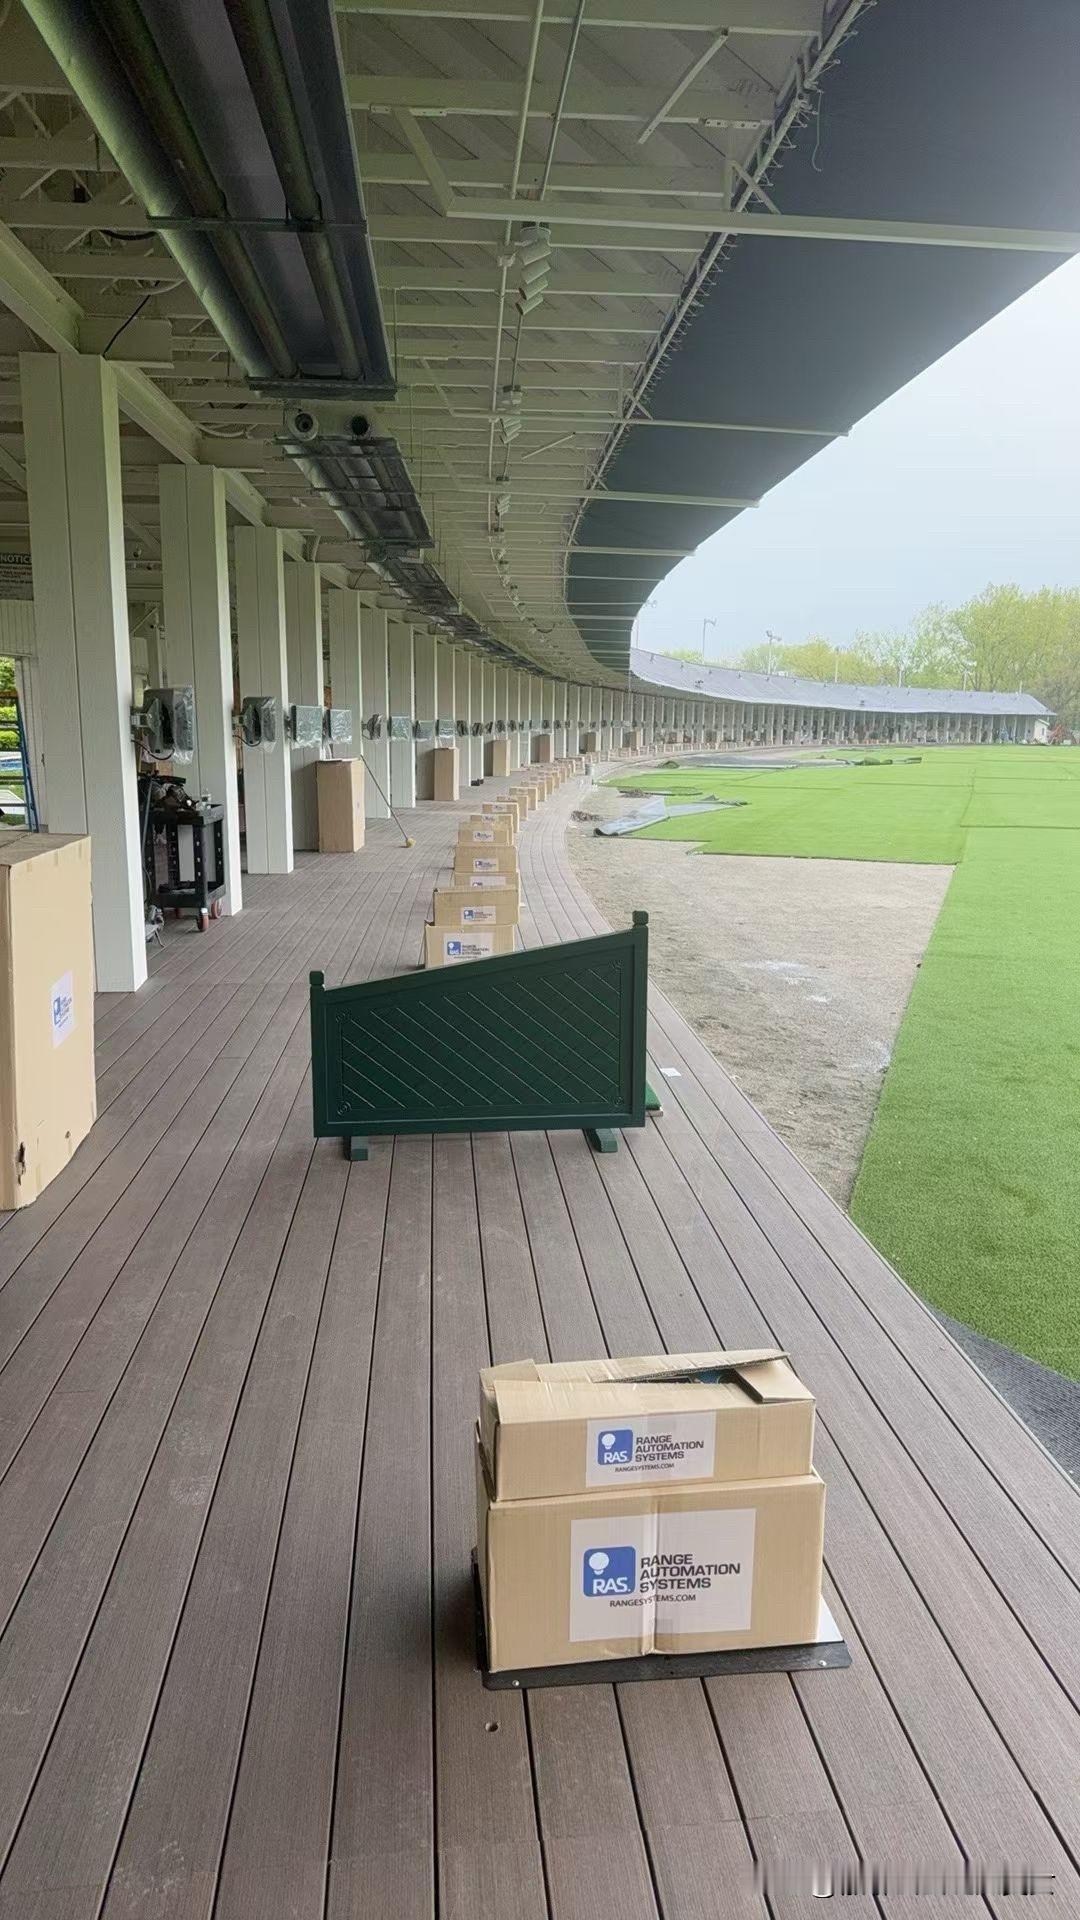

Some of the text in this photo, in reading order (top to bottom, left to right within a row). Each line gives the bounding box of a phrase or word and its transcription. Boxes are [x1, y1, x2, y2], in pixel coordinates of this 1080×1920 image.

[0, 554, 32, 563] NOTIC
[636, 1434, 673, 1446] RANGE
[635, 1440, 705, 1455] AUTOMATION
[635, 1450, 685, 1463] SYSTEMS
[614, 1462, 675, 1473] RANGESYSTEMS.COM
[640, 1553, 694, 1569] RANGE
[639, 1562, 741, 1581] AUTOMATION
[639, 1576, 712, 1594] SYSTEMS
[609, 1594, 696, 1608] RANGESYSTEMS.COM
